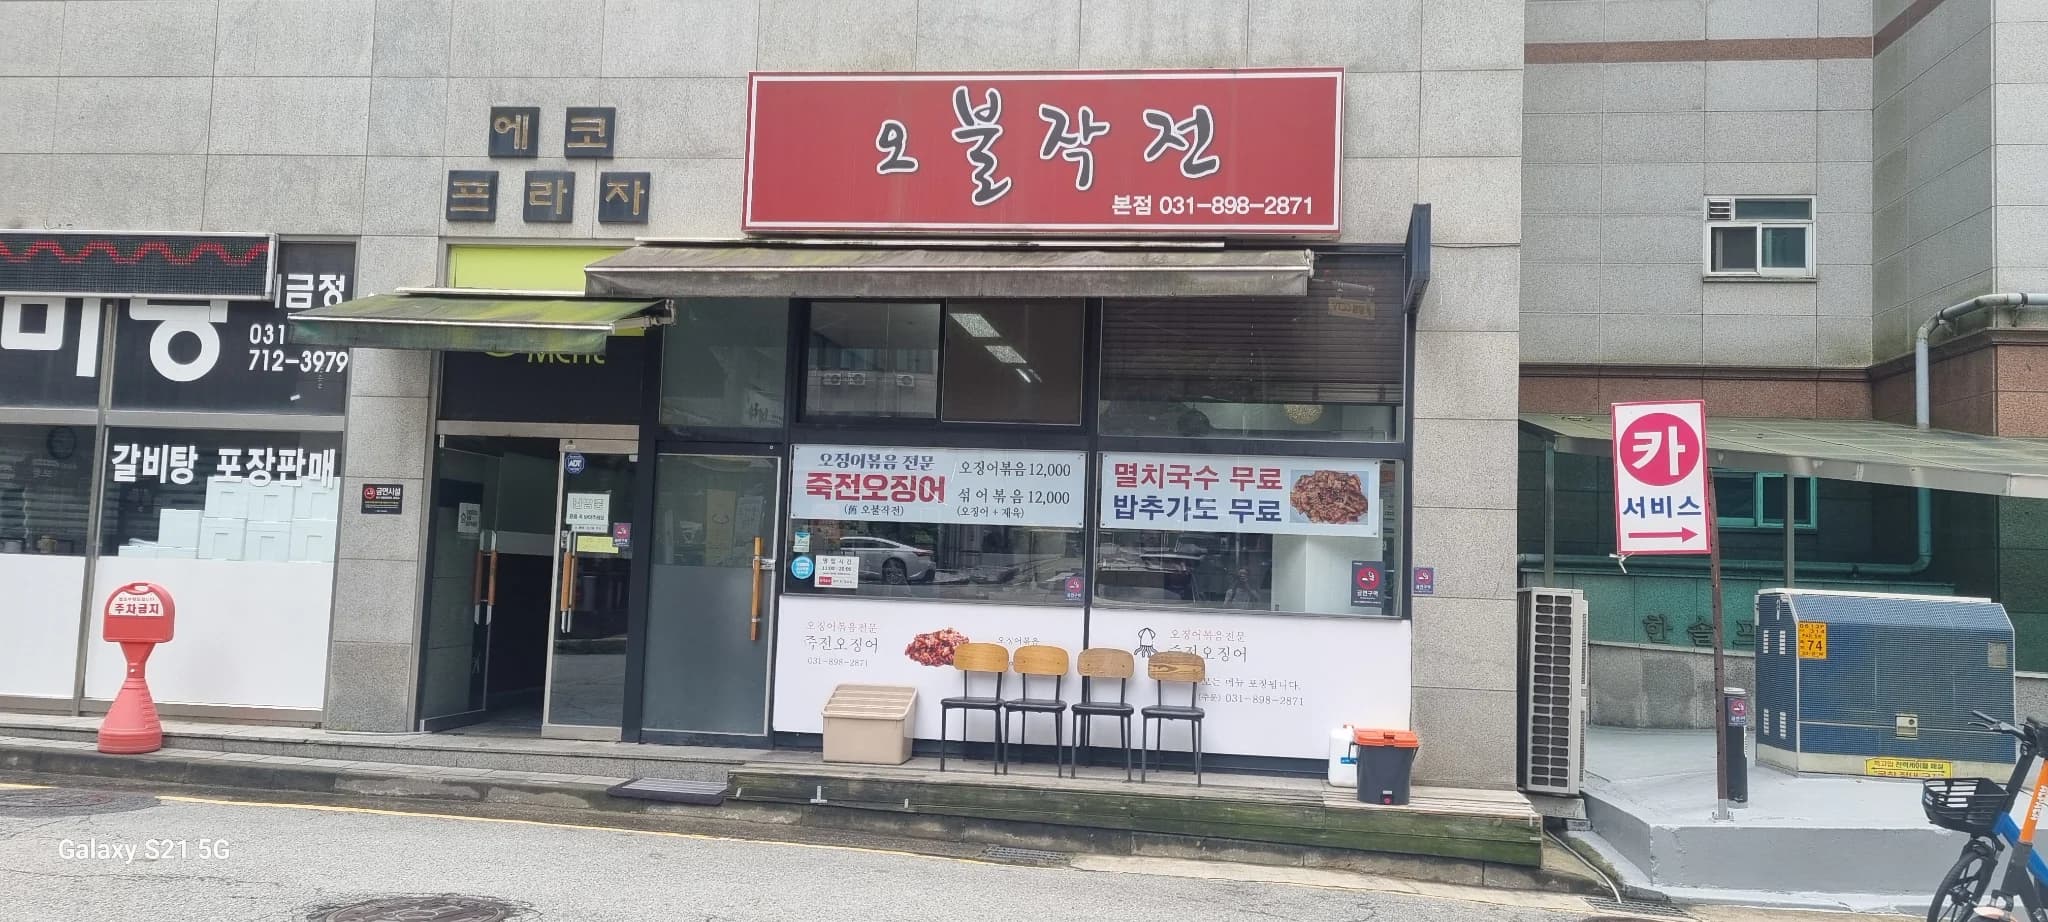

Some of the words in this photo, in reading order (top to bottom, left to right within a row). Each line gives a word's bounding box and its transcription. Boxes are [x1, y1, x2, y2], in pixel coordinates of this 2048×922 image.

[875, 85, 1221, 207] 오불작전
[449, 178, 646, 216] 프라자
[1111, 194, 1152, 216] 본점
[1159, 195, 1313, 216] 031-898-2871
[275, 273, 346, 309] 금정
[249, 349, 349, 373] 712-3979
[818, 452, 899, 470] 오징어볶음
[902, 455, 935, 471] 전문
[1631, 425, 1686, 477] 카
[111, 443, 199, 486] 갈비탕
[216, 446, 337, 489] 포장판매
[959, 460, 1027, 477] 오징어볶음
[1029, 463, 1071, 478] 12,000
[1114, 462, 1220, 491] 멸치국수
[1229, 465, 1283, 491] 무료
[805, 472, 946, 503] 죽전오징어
[1028, 490, 1070, 505] 12,000
[956, 505, 989, 518] (오징어
[1113, 494, 1219, 523] 밥추가도
[1228, 497, 1283, 524] 무료
[1622, 495, 1703, 519] 서비스
[114, 603, 159, 615] 주차금지
[1807, 640, 1823, 652] 74
